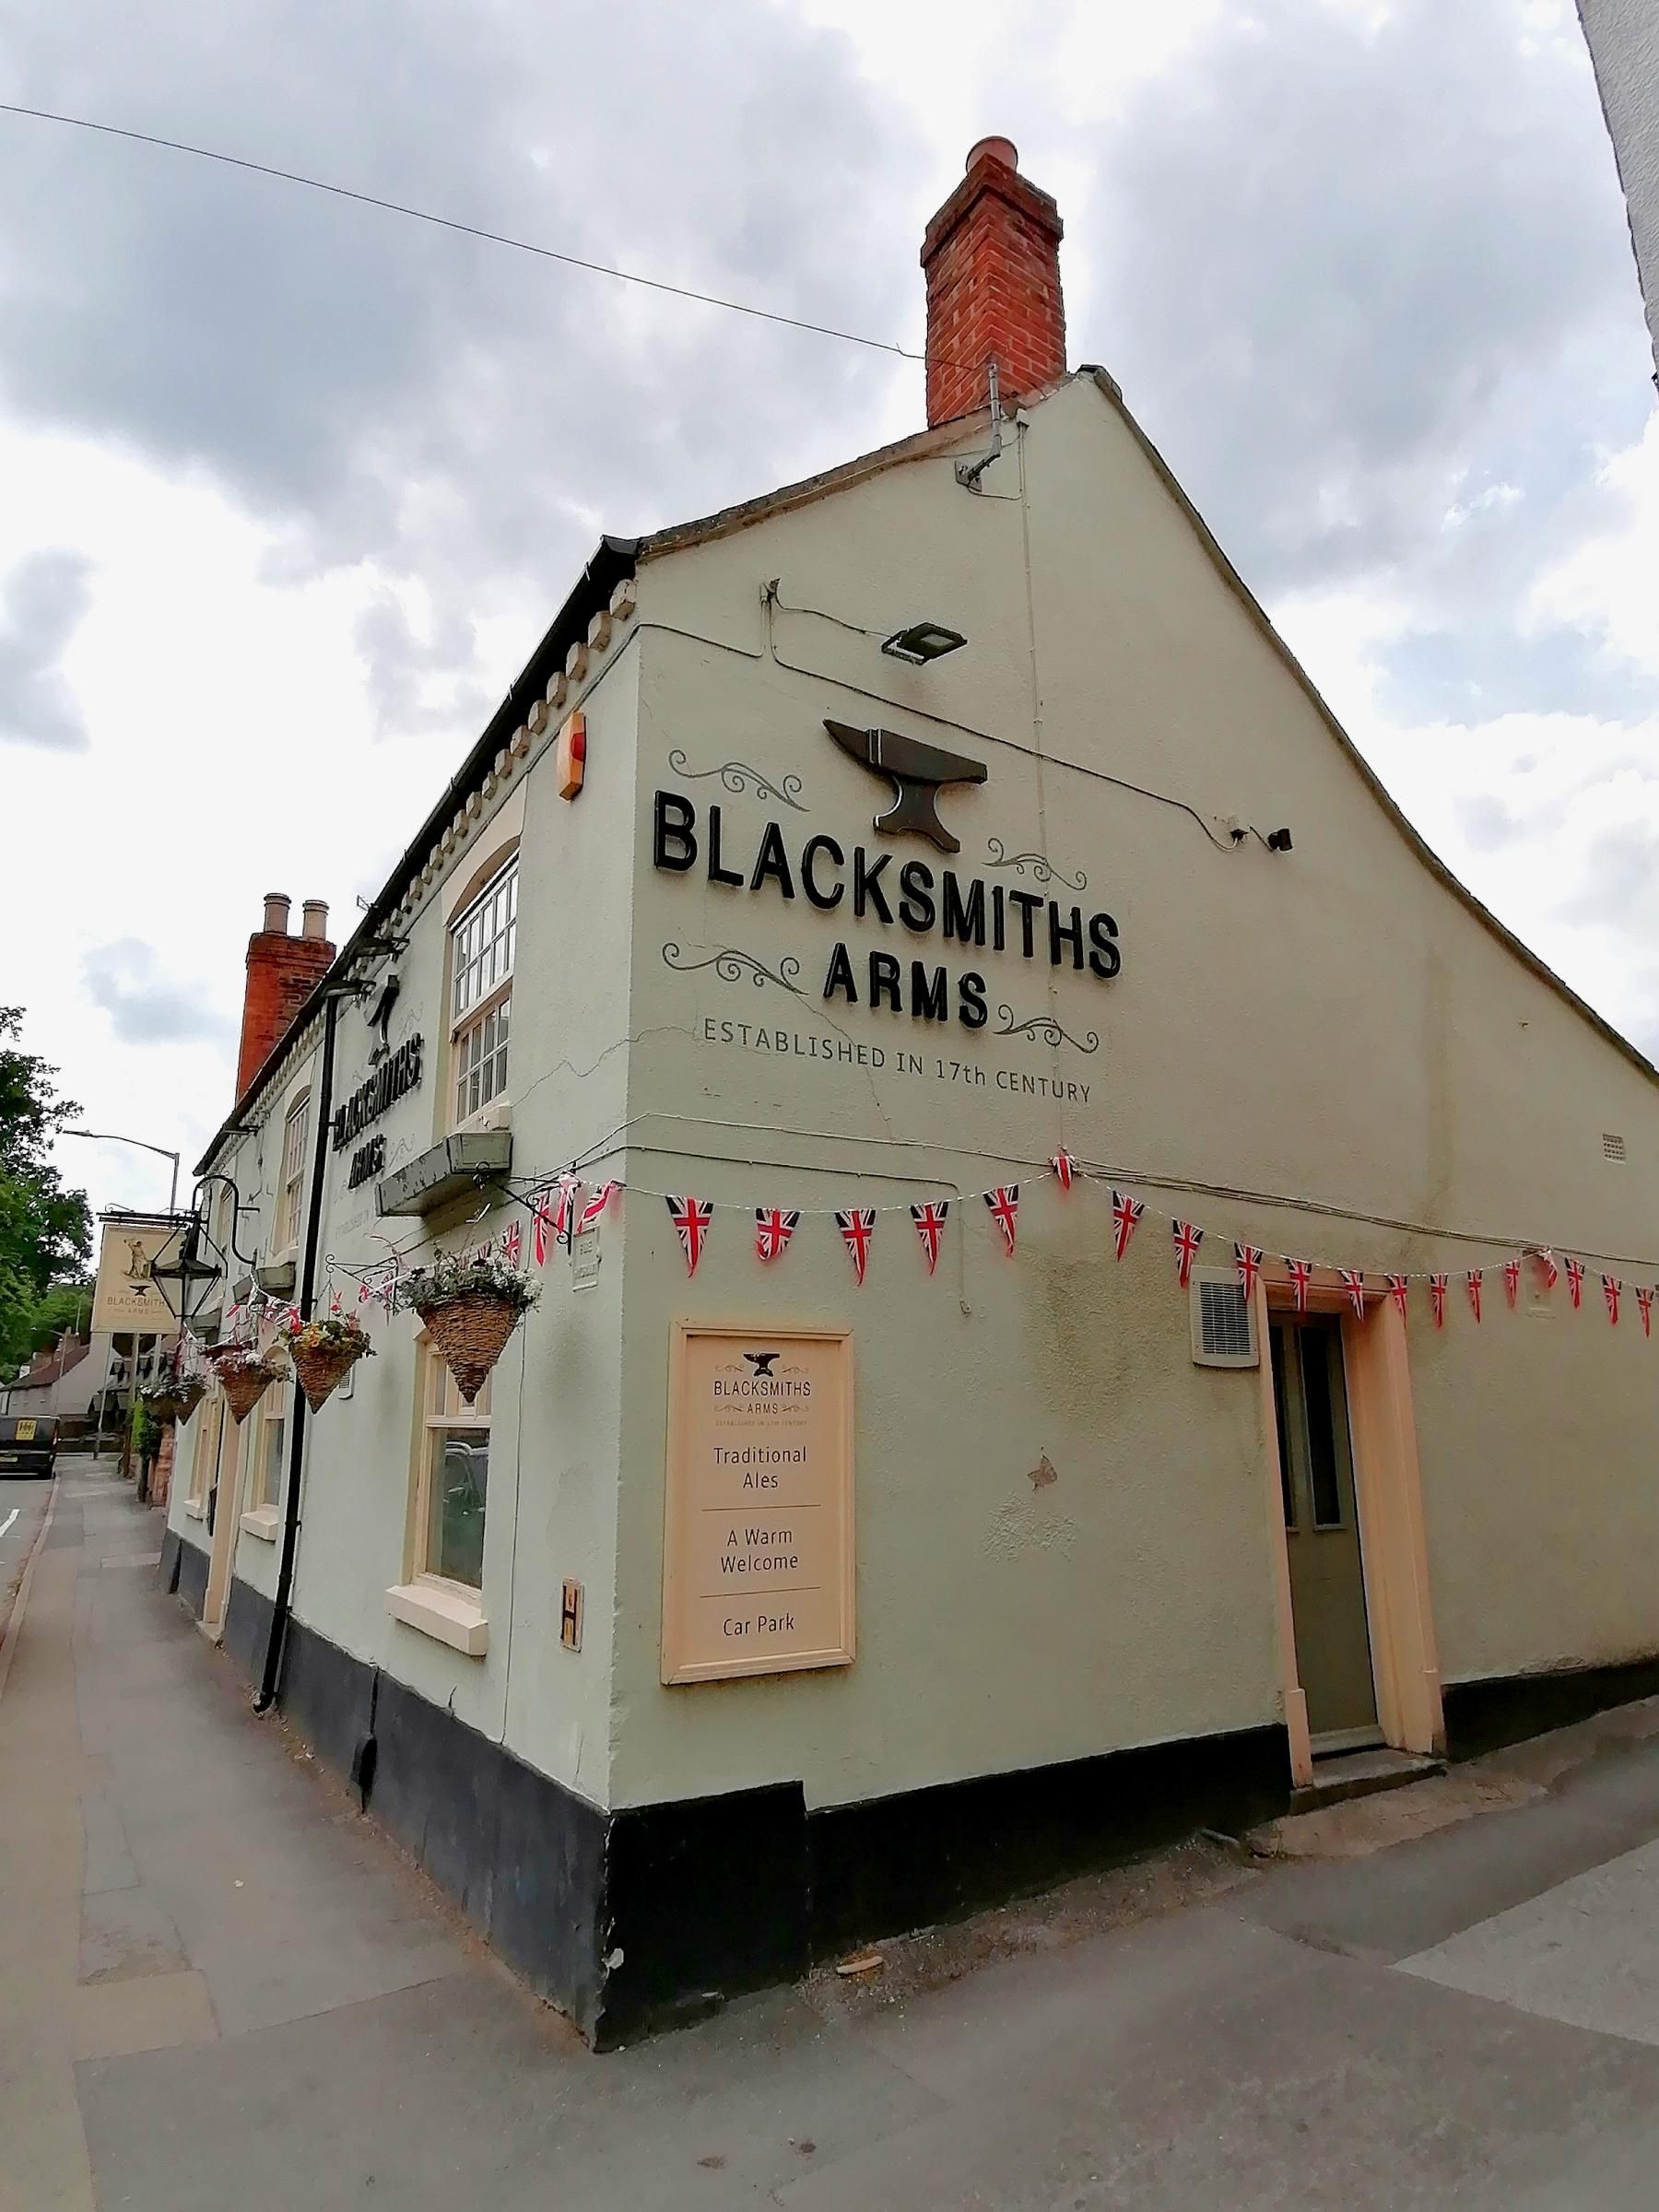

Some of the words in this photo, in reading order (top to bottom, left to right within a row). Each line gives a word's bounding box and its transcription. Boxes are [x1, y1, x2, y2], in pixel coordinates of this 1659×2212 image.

[653, 789, 1122, 979] BLACKSMITHS
[823, 941, 989, 1030] ARMS
[704, 1018, 886, 1068] ESTABLISHED
[897, 1053, 923, 1075] IN
[936, 1060, 985, 1086] 17th
[996, 1071, 1090, 1103] CENTURY
[714, 1381, 811, 1396] BLACKSMITHS
[747, 1403, 779, 1415] ARMS
[713, 1445, 806, 1464] Traditional
[743, 1472, 779, 1489] Ales
[727, 1530, 737, 1547] A
[745, 1528, 793, 1546] Warm
[721, 1554, 798, 1574] Welcome
[724, 1618, 751, 1636] Car
[758, 1613, 794, 1633] Park
